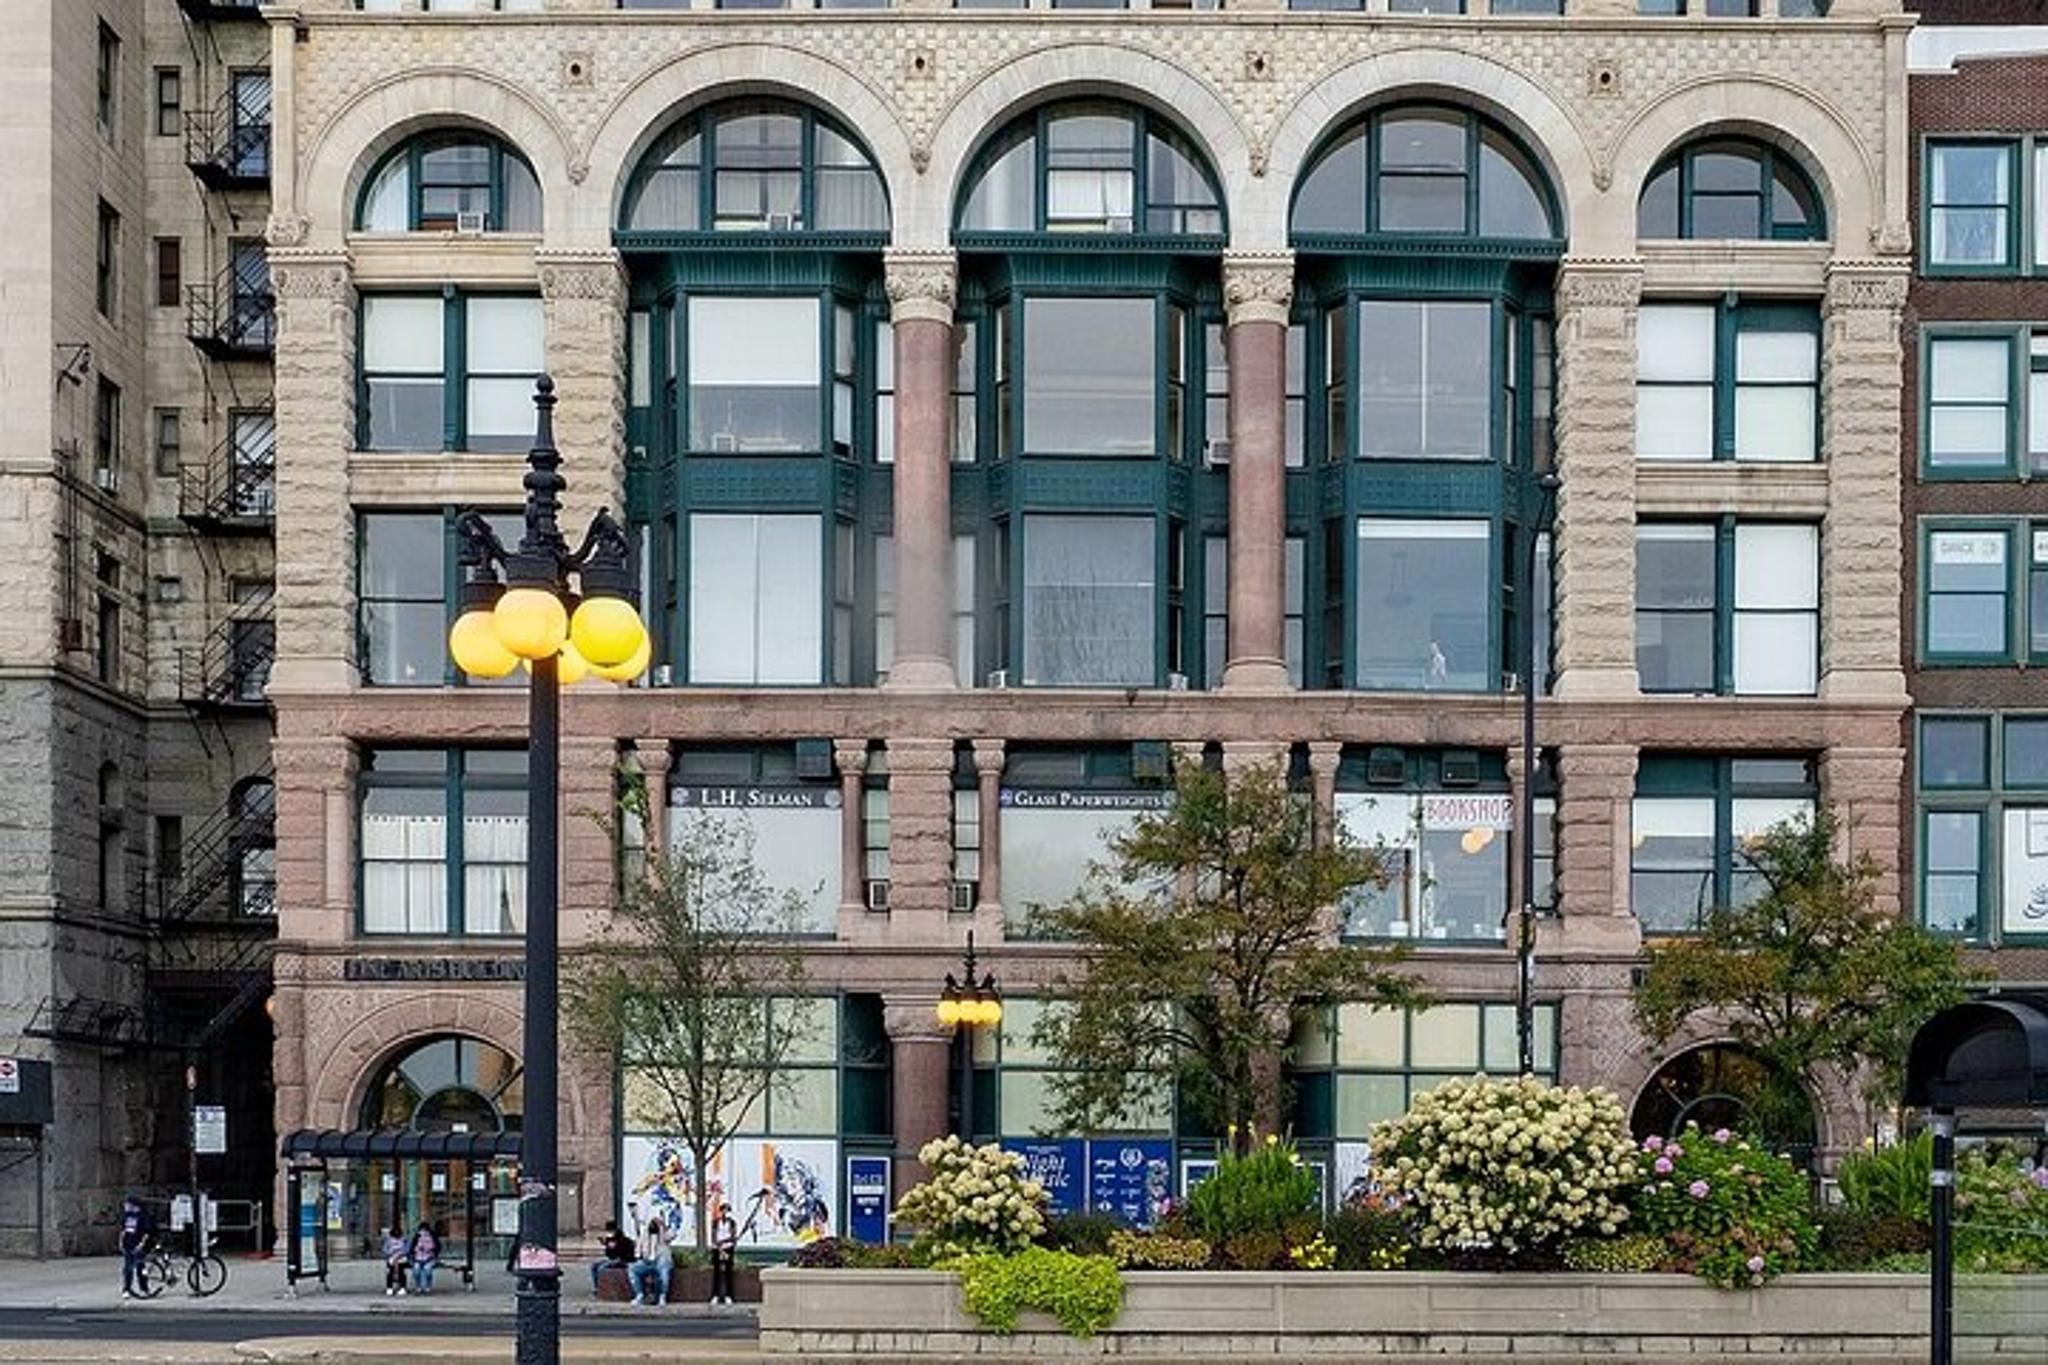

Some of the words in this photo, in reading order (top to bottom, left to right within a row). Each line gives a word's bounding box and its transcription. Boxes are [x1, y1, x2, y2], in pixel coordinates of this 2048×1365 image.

[1014, 790, 1056, 806] GLASS
[1060, 790, 1162, 806] PAPERWEIGHTS
[1427, 799, 1514, 821] BOOKSHOP
[453, 958, 527, 979] BUILDIN
